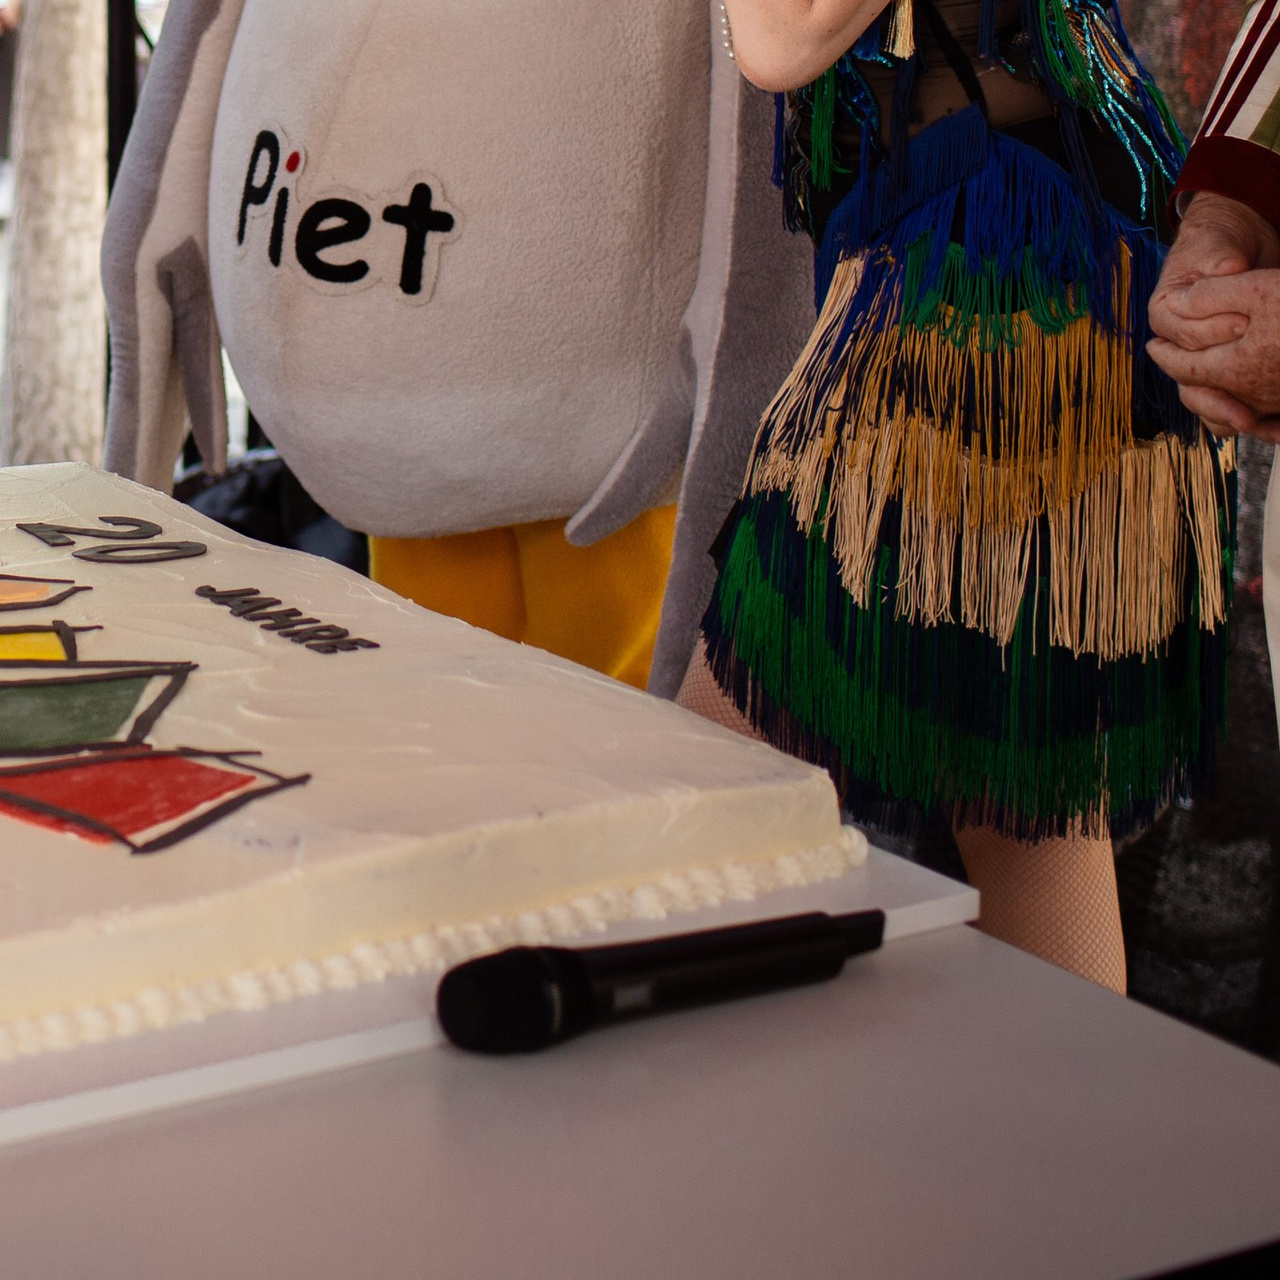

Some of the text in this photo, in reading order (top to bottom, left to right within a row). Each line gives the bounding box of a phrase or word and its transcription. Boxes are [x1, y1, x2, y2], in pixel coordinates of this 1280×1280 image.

[237, 130, 454, 295] Piet
[16, 516, 207, 563] 20
[195, 585, 380, 654] JAHRE
